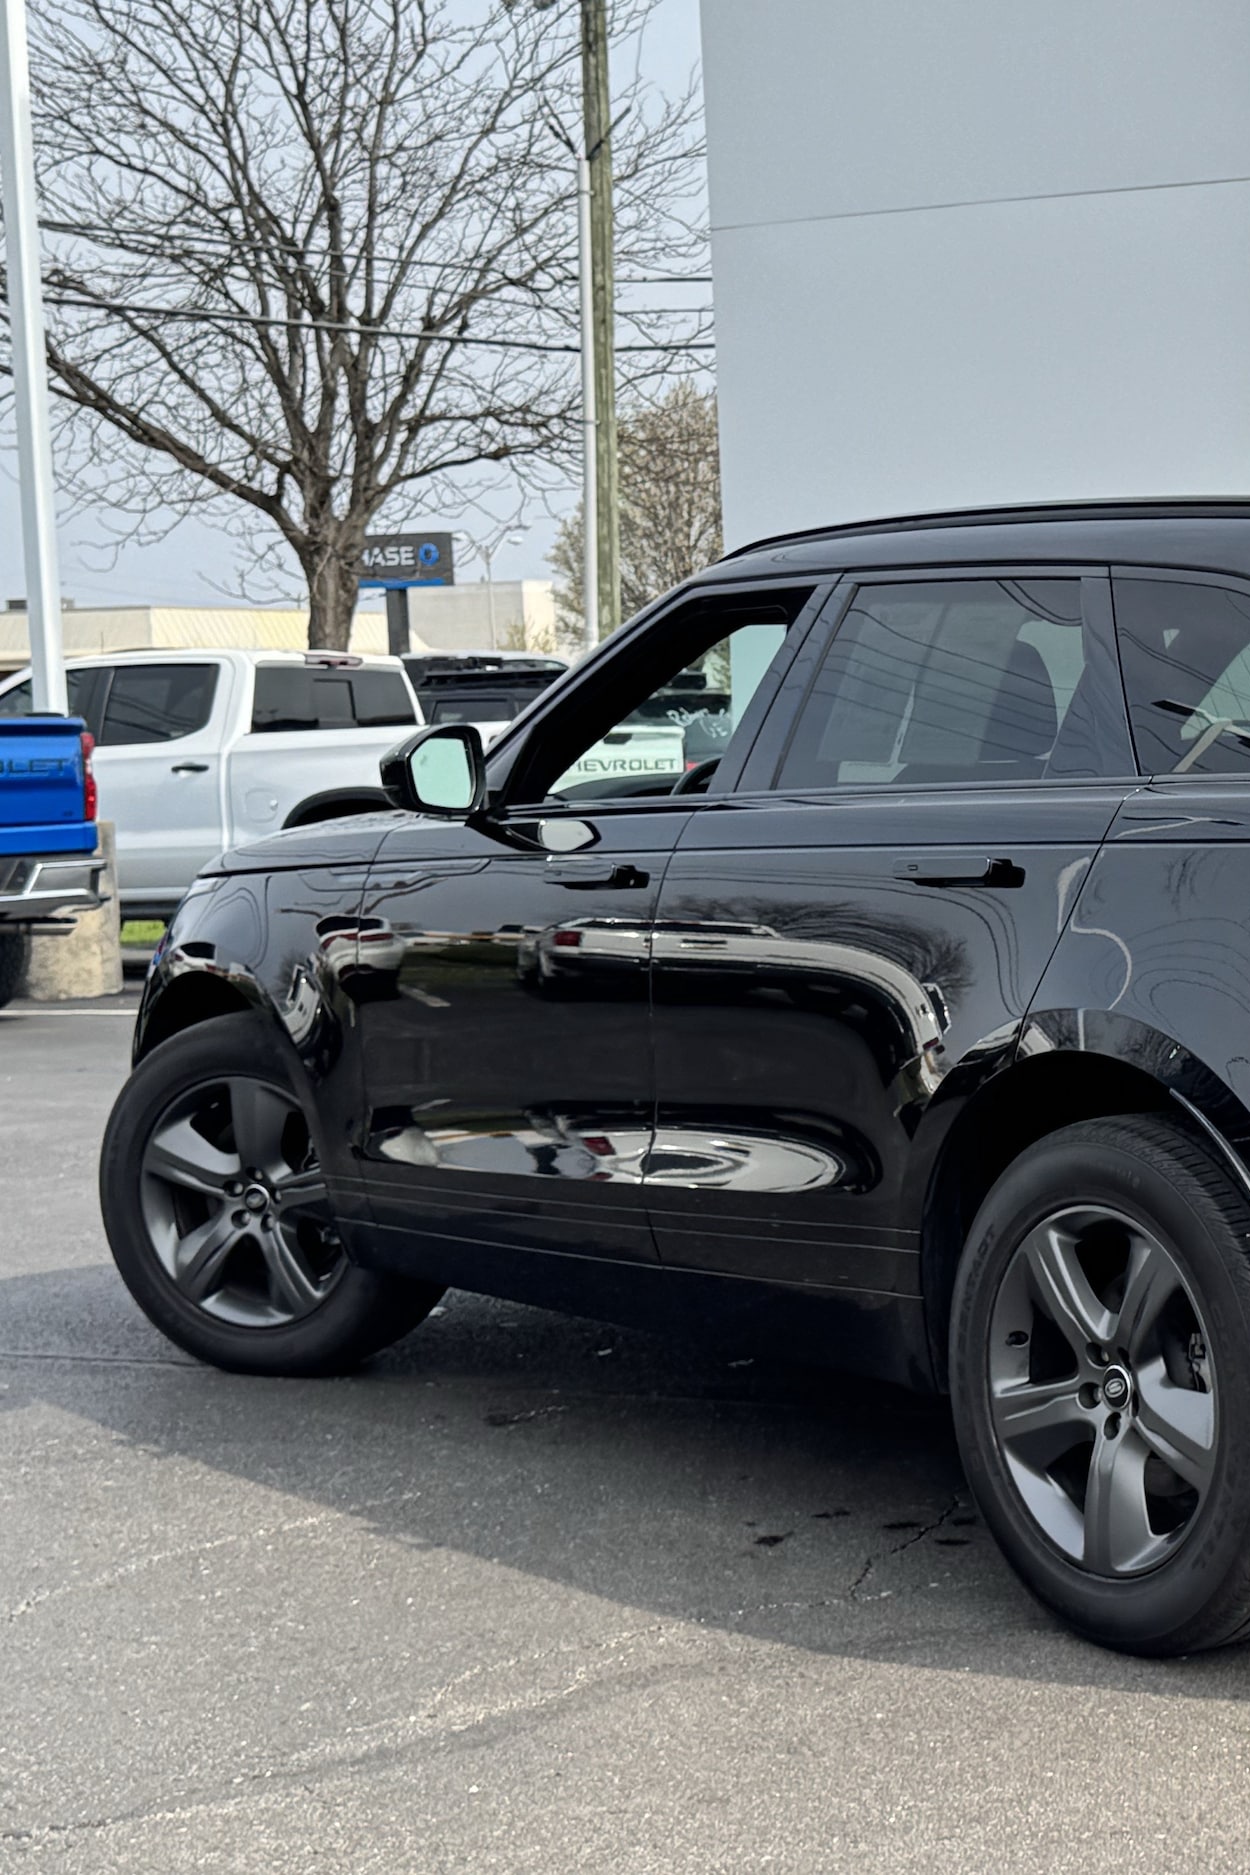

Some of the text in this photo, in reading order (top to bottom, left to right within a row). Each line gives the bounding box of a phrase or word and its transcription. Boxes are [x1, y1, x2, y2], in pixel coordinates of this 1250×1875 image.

[361, 546, 415, 567] ASE
[0, 758, 71, 773] LET
[576, 757, 677, 772] EVROLET
